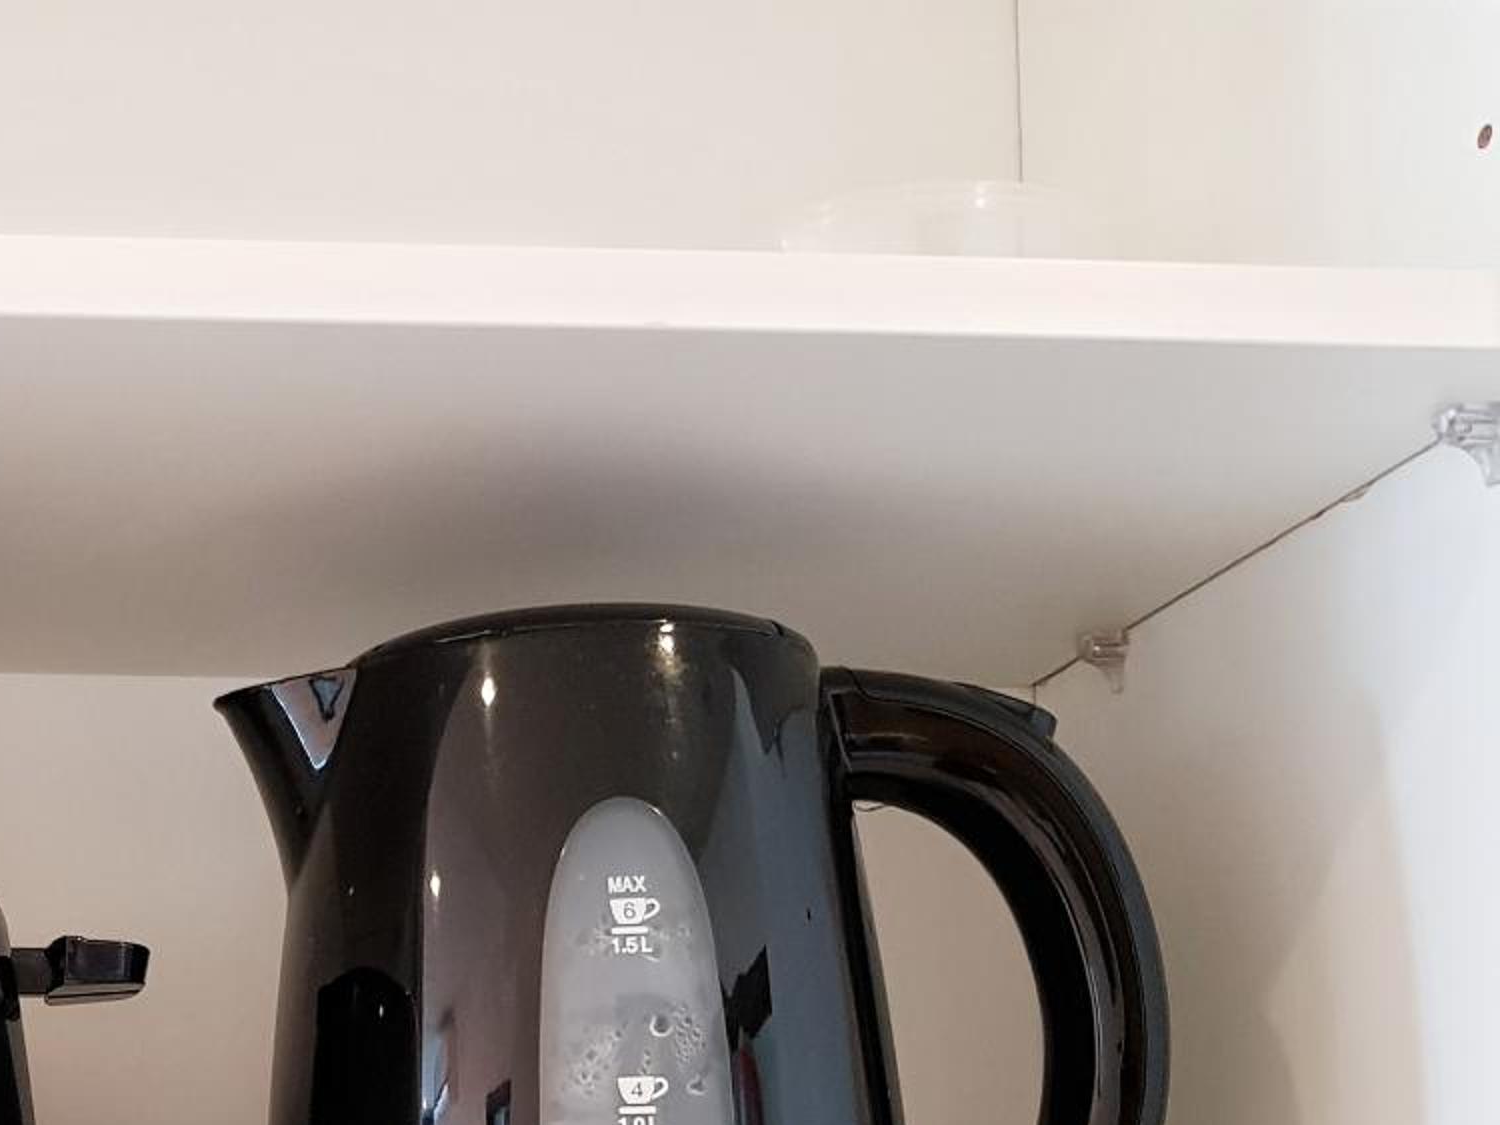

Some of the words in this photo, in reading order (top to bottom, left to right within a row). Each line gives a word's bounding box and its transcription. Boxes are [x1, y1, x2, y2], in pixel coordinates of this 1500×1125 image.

[607, 875, 647, 894] MAX
[622, 901, 636, 919] 6
[630, 1080, 643, 1098] 4
